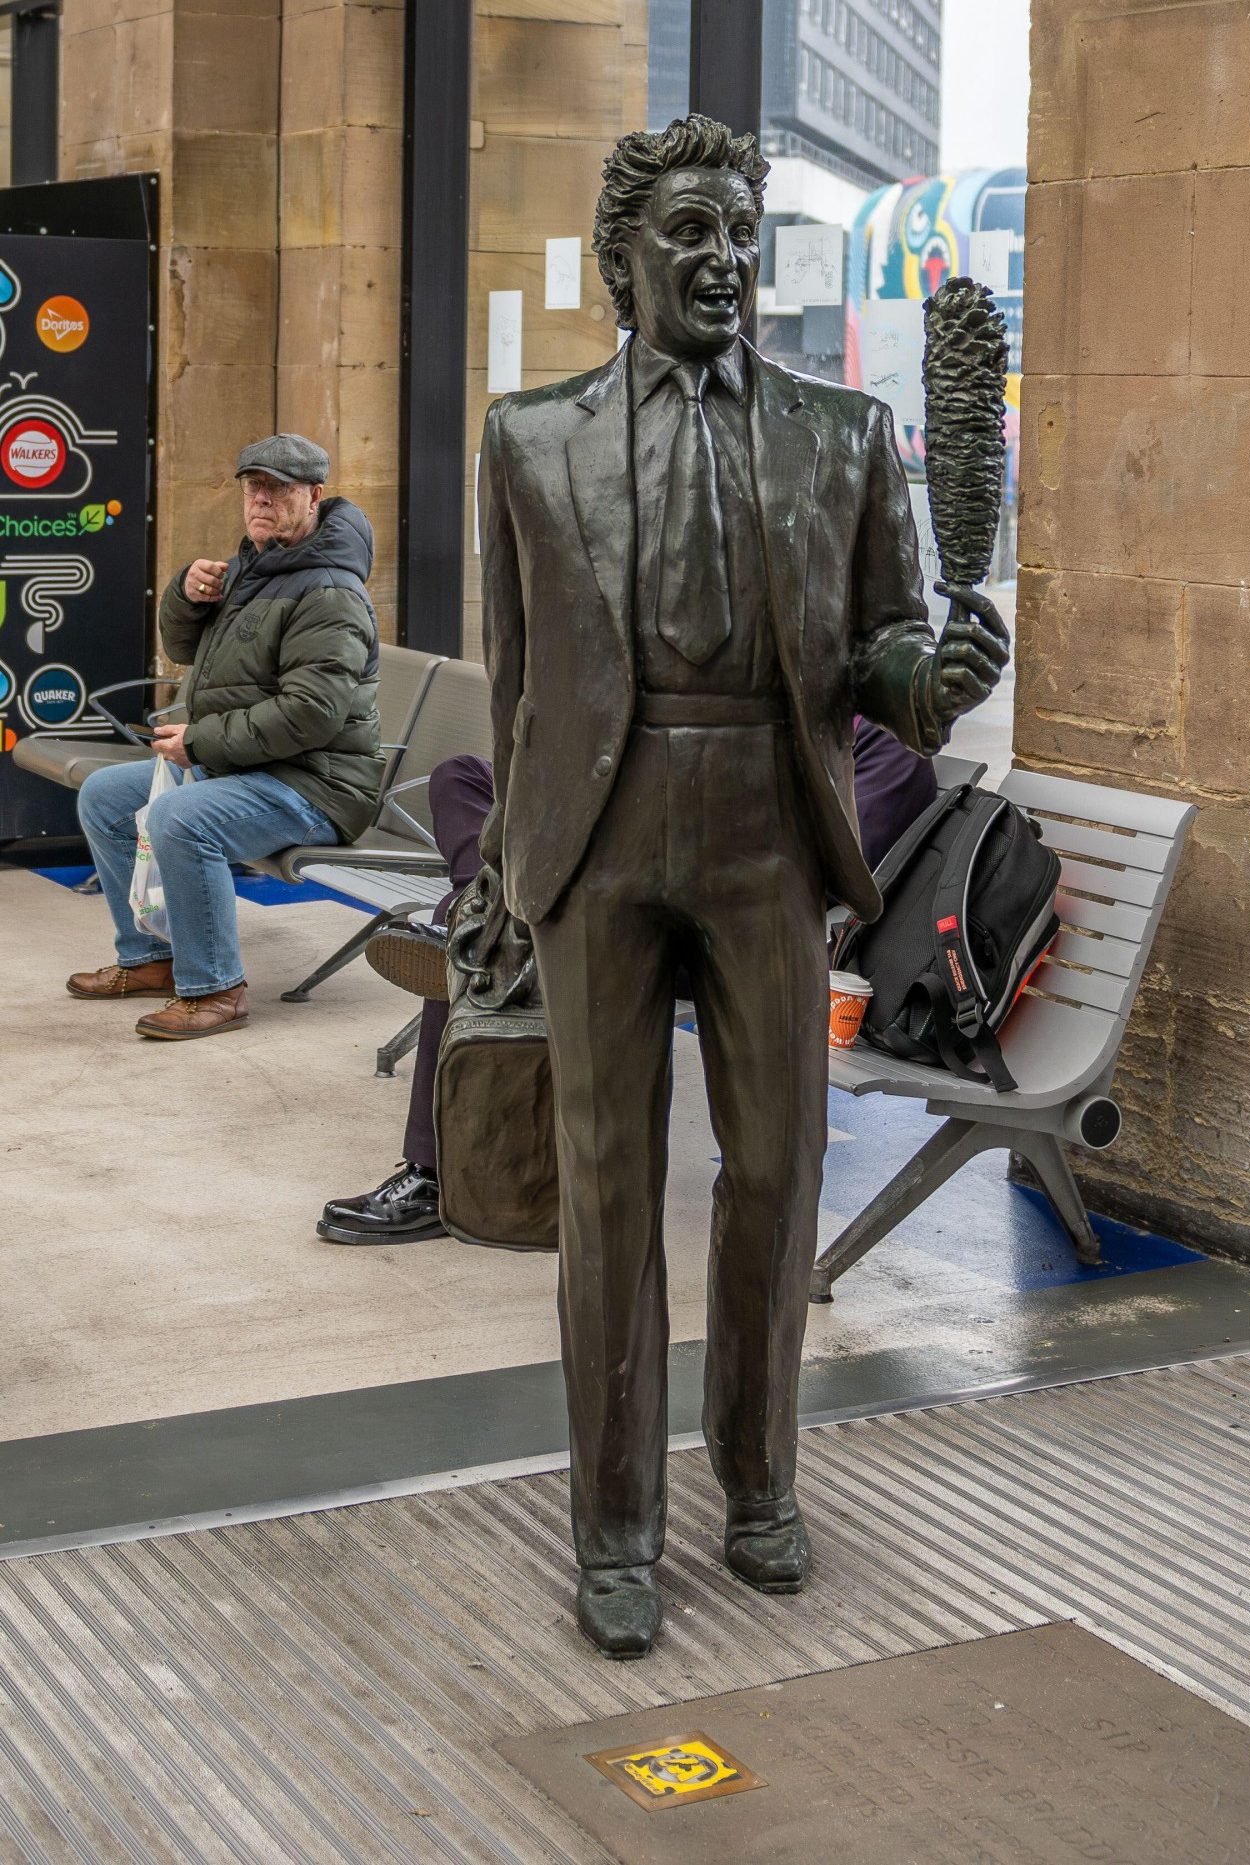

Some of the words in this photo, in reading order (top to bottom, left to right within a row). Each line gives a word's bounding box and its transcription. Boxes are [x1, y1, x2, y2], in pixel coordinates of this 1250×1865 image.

[41, 318, 84, 331] Doritos
[11, 447, 56, 460] WALKERS
[0, 515, 77, 537] hoices
[33, 689, 76, 703] QUAKER
[1075, 1717, 1158, 1757] SIR
[891, 1714, 1011, 1782] BESSIE
